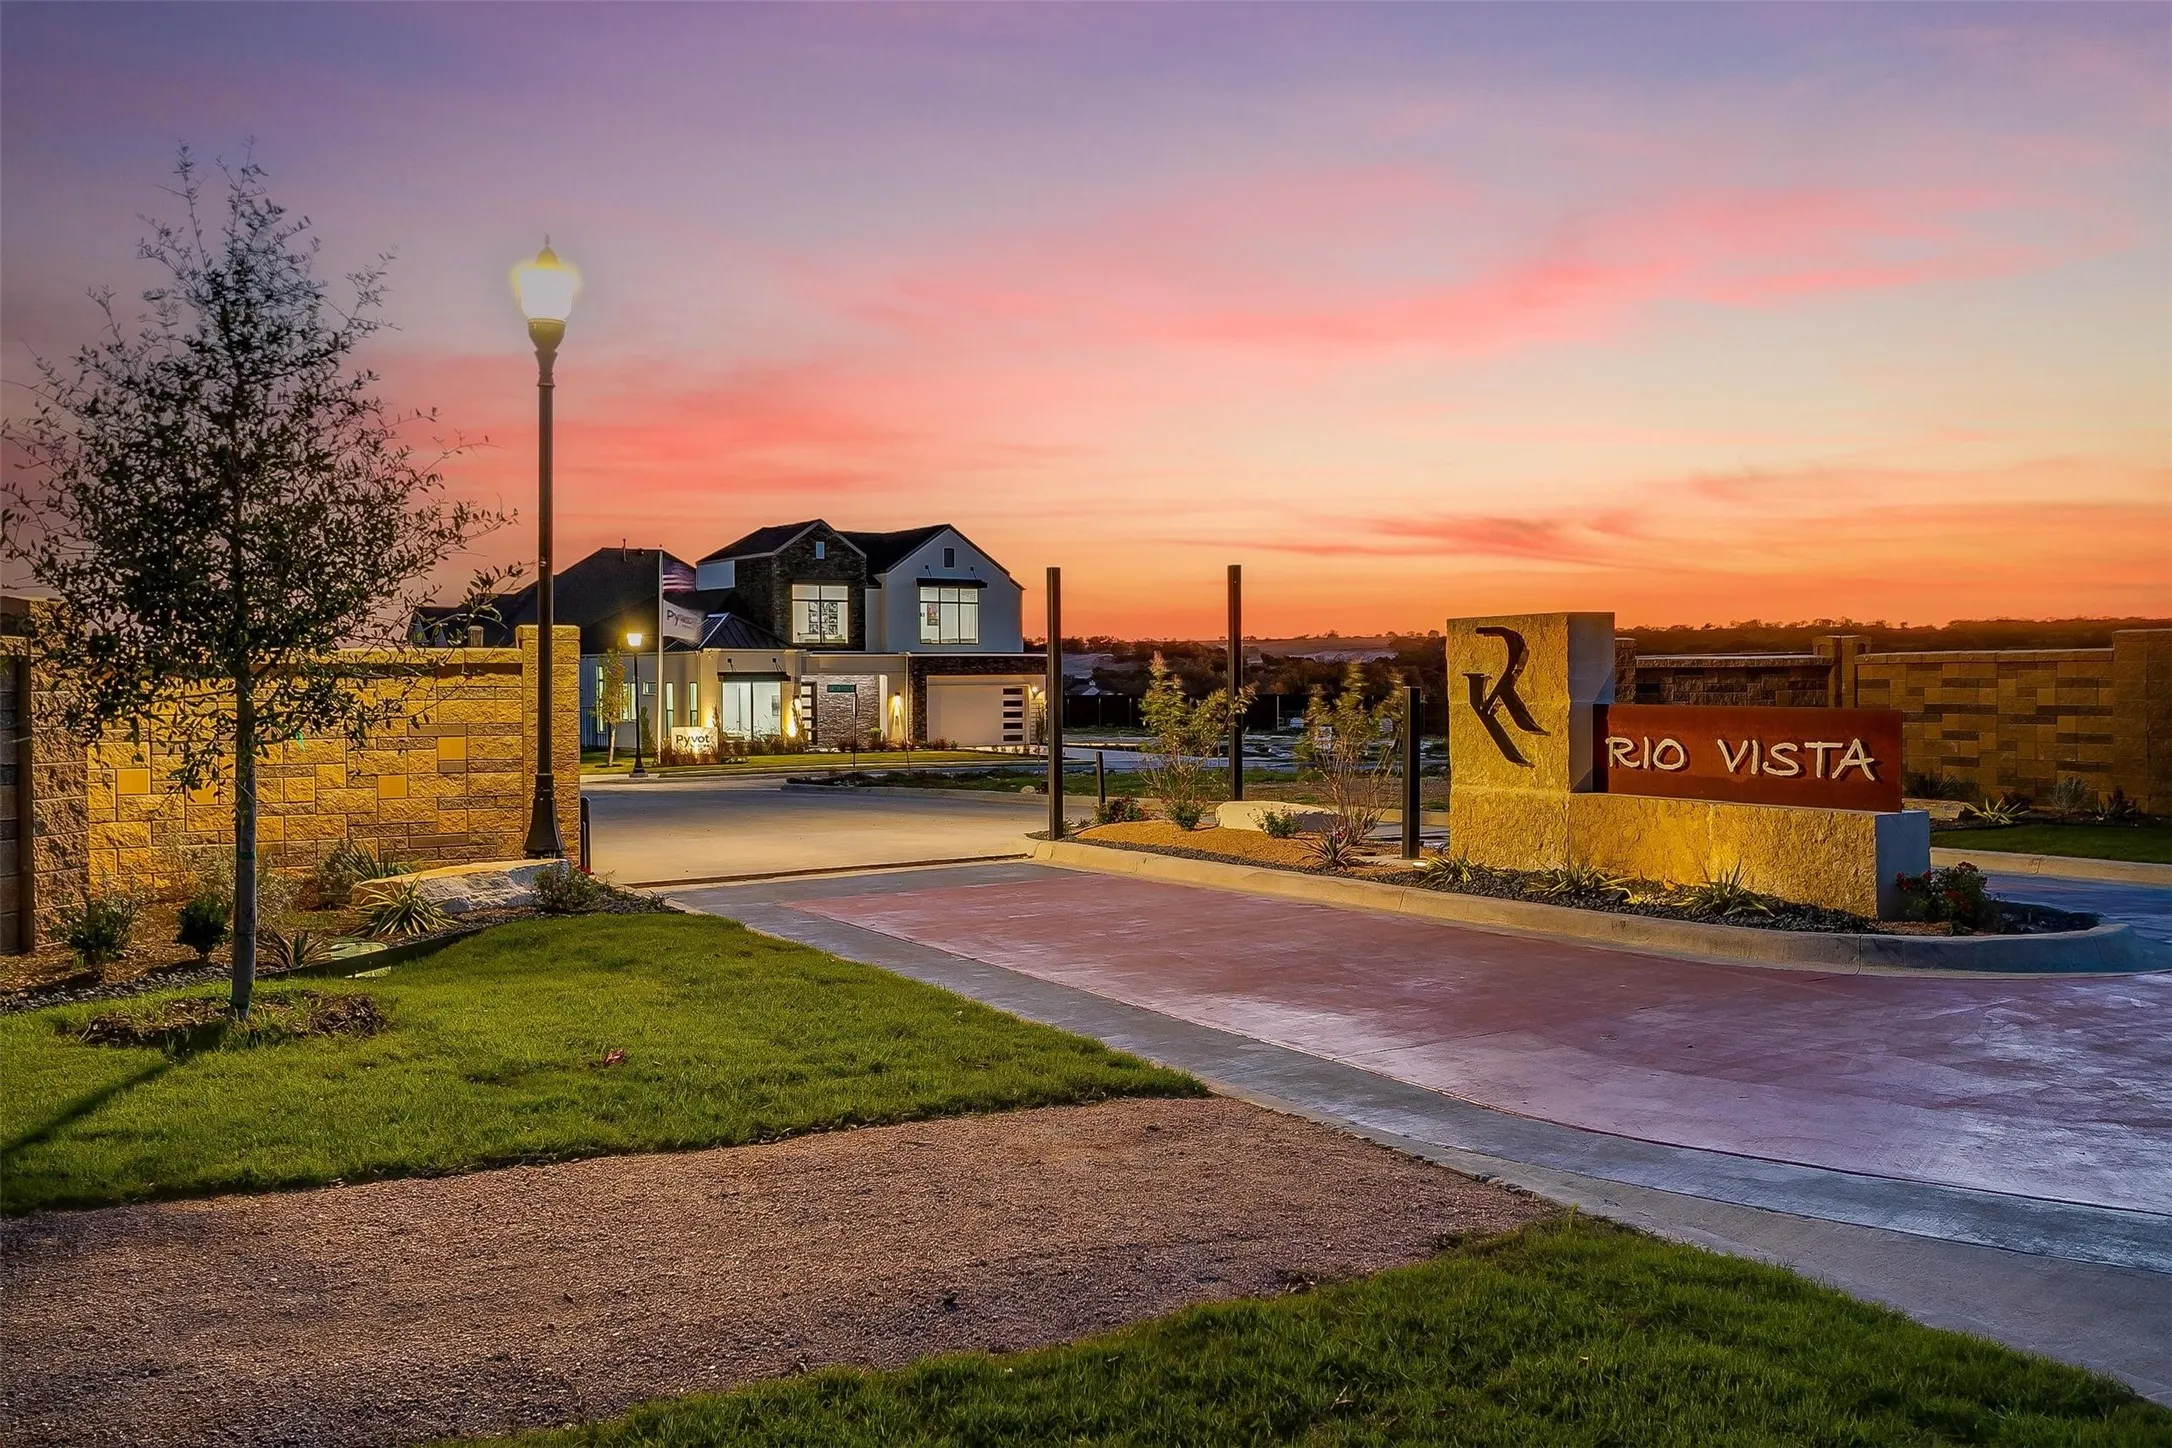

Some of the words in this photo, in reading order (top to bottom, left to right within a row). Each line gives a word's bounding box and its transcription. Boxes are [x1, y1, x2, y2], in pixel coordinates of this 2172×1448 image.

[675, 734, 710, 748] Pyvot
[1605, 736, 1686, 771] RIO
[1717, 737, 1876, 782] VISTA
